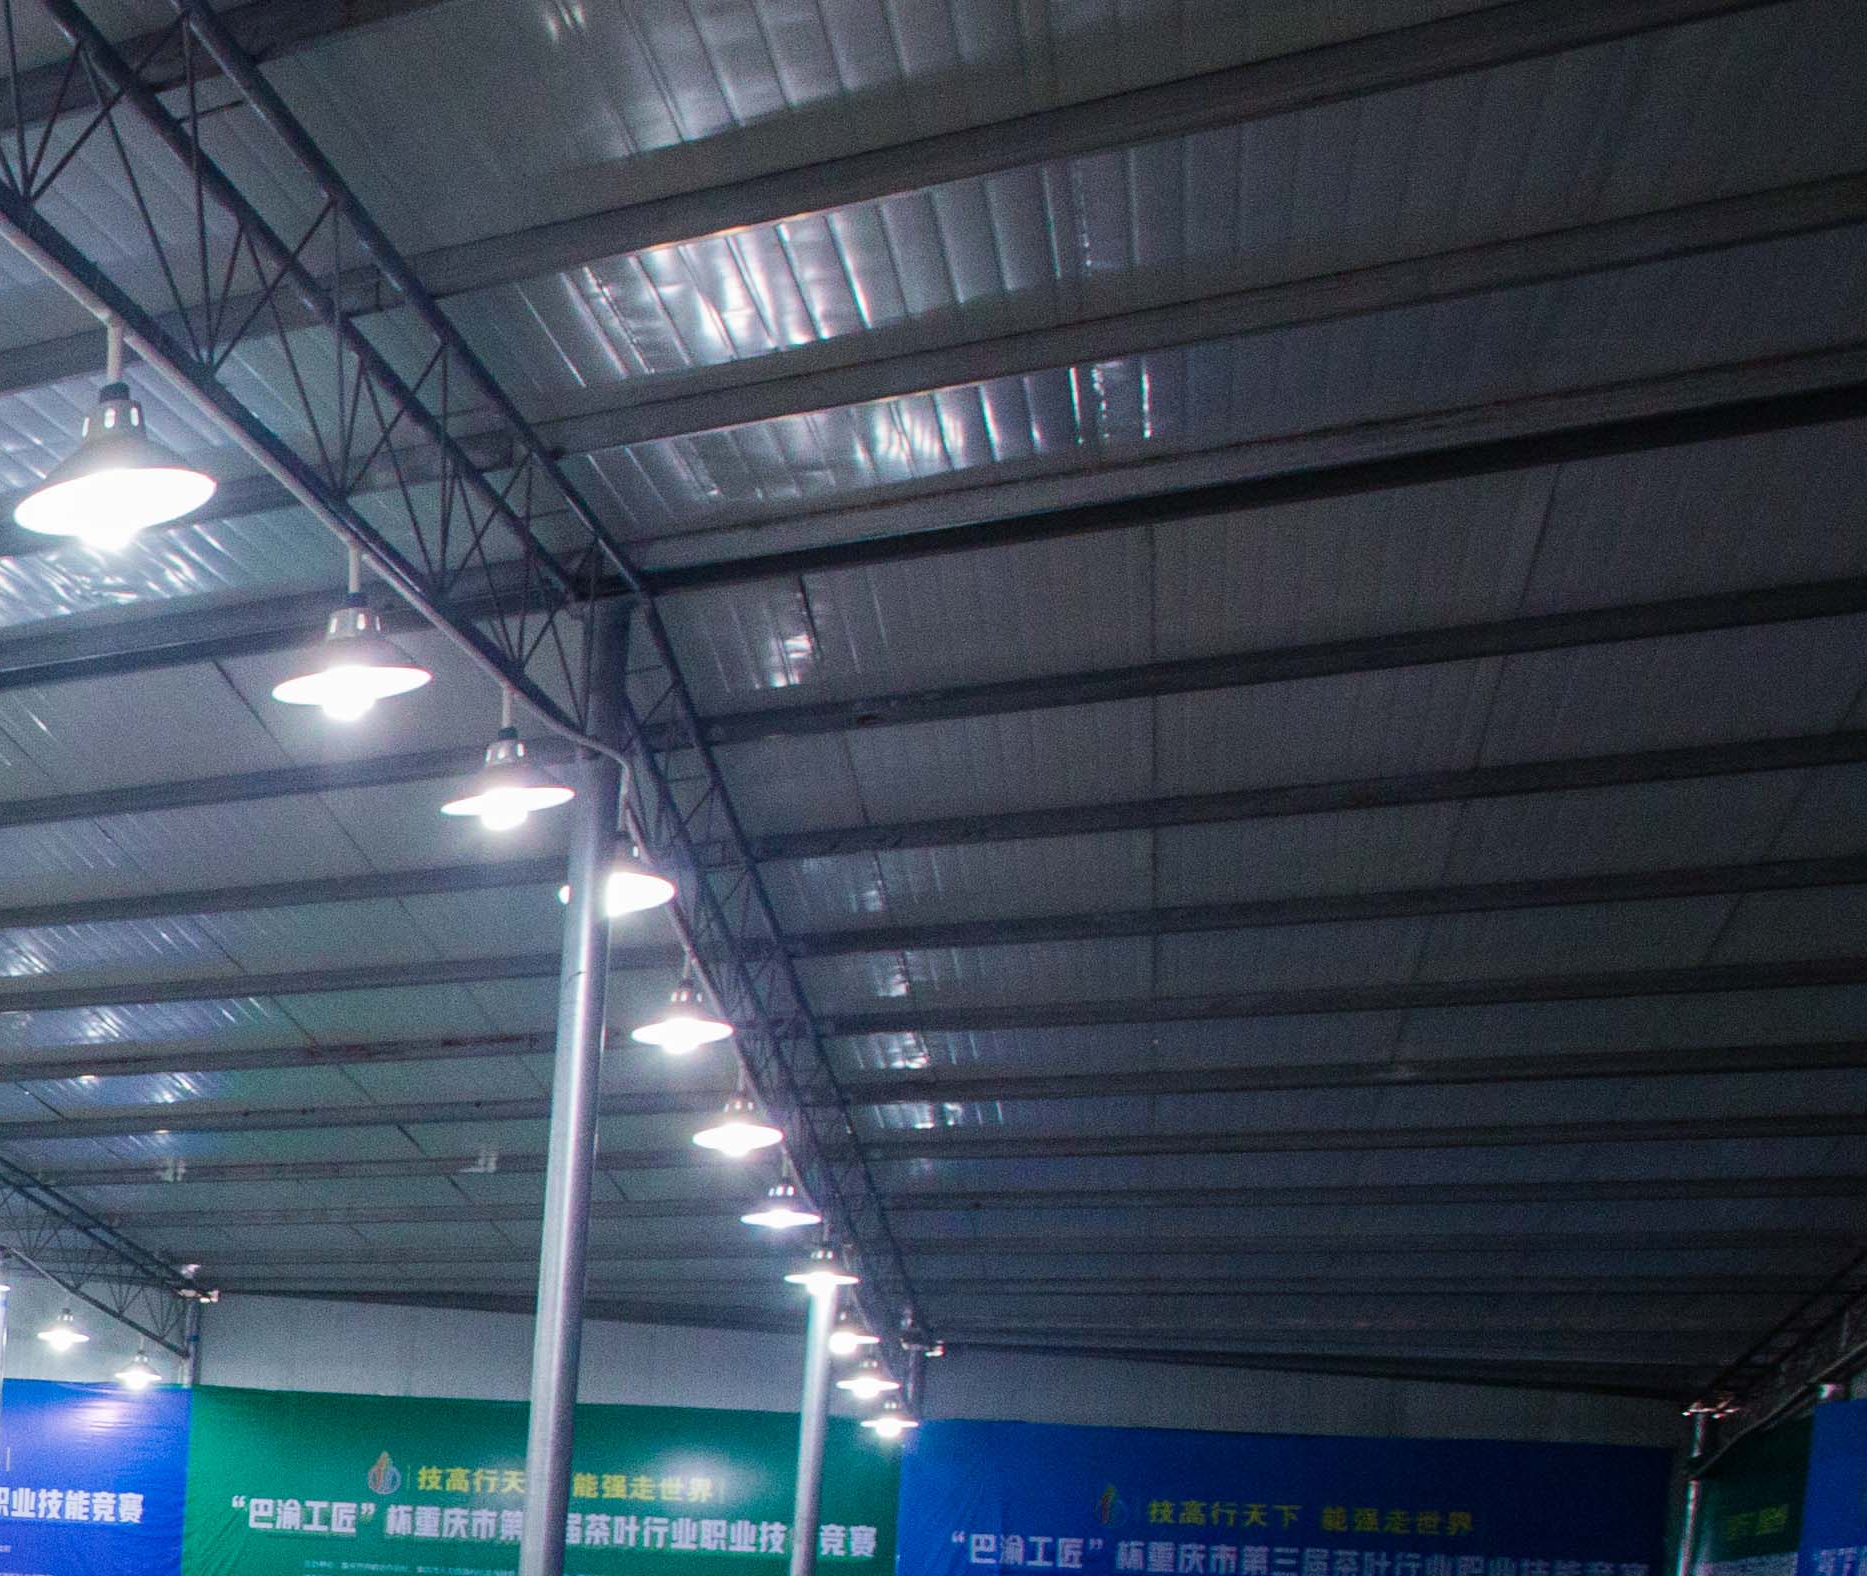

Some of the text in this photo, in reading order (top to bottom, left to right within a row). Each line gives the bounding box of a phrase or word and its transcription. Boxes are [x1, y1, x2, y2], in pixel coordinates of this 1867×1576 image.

[417, 1465, 714, 1504] 技高行天 能强走世界
[231, 1493, 878, 1558] “巴渝工匠”杯重庆市第届茶叶行业职业技竞赛
[1149, 1499, 1303, 1530] 技高行天下
